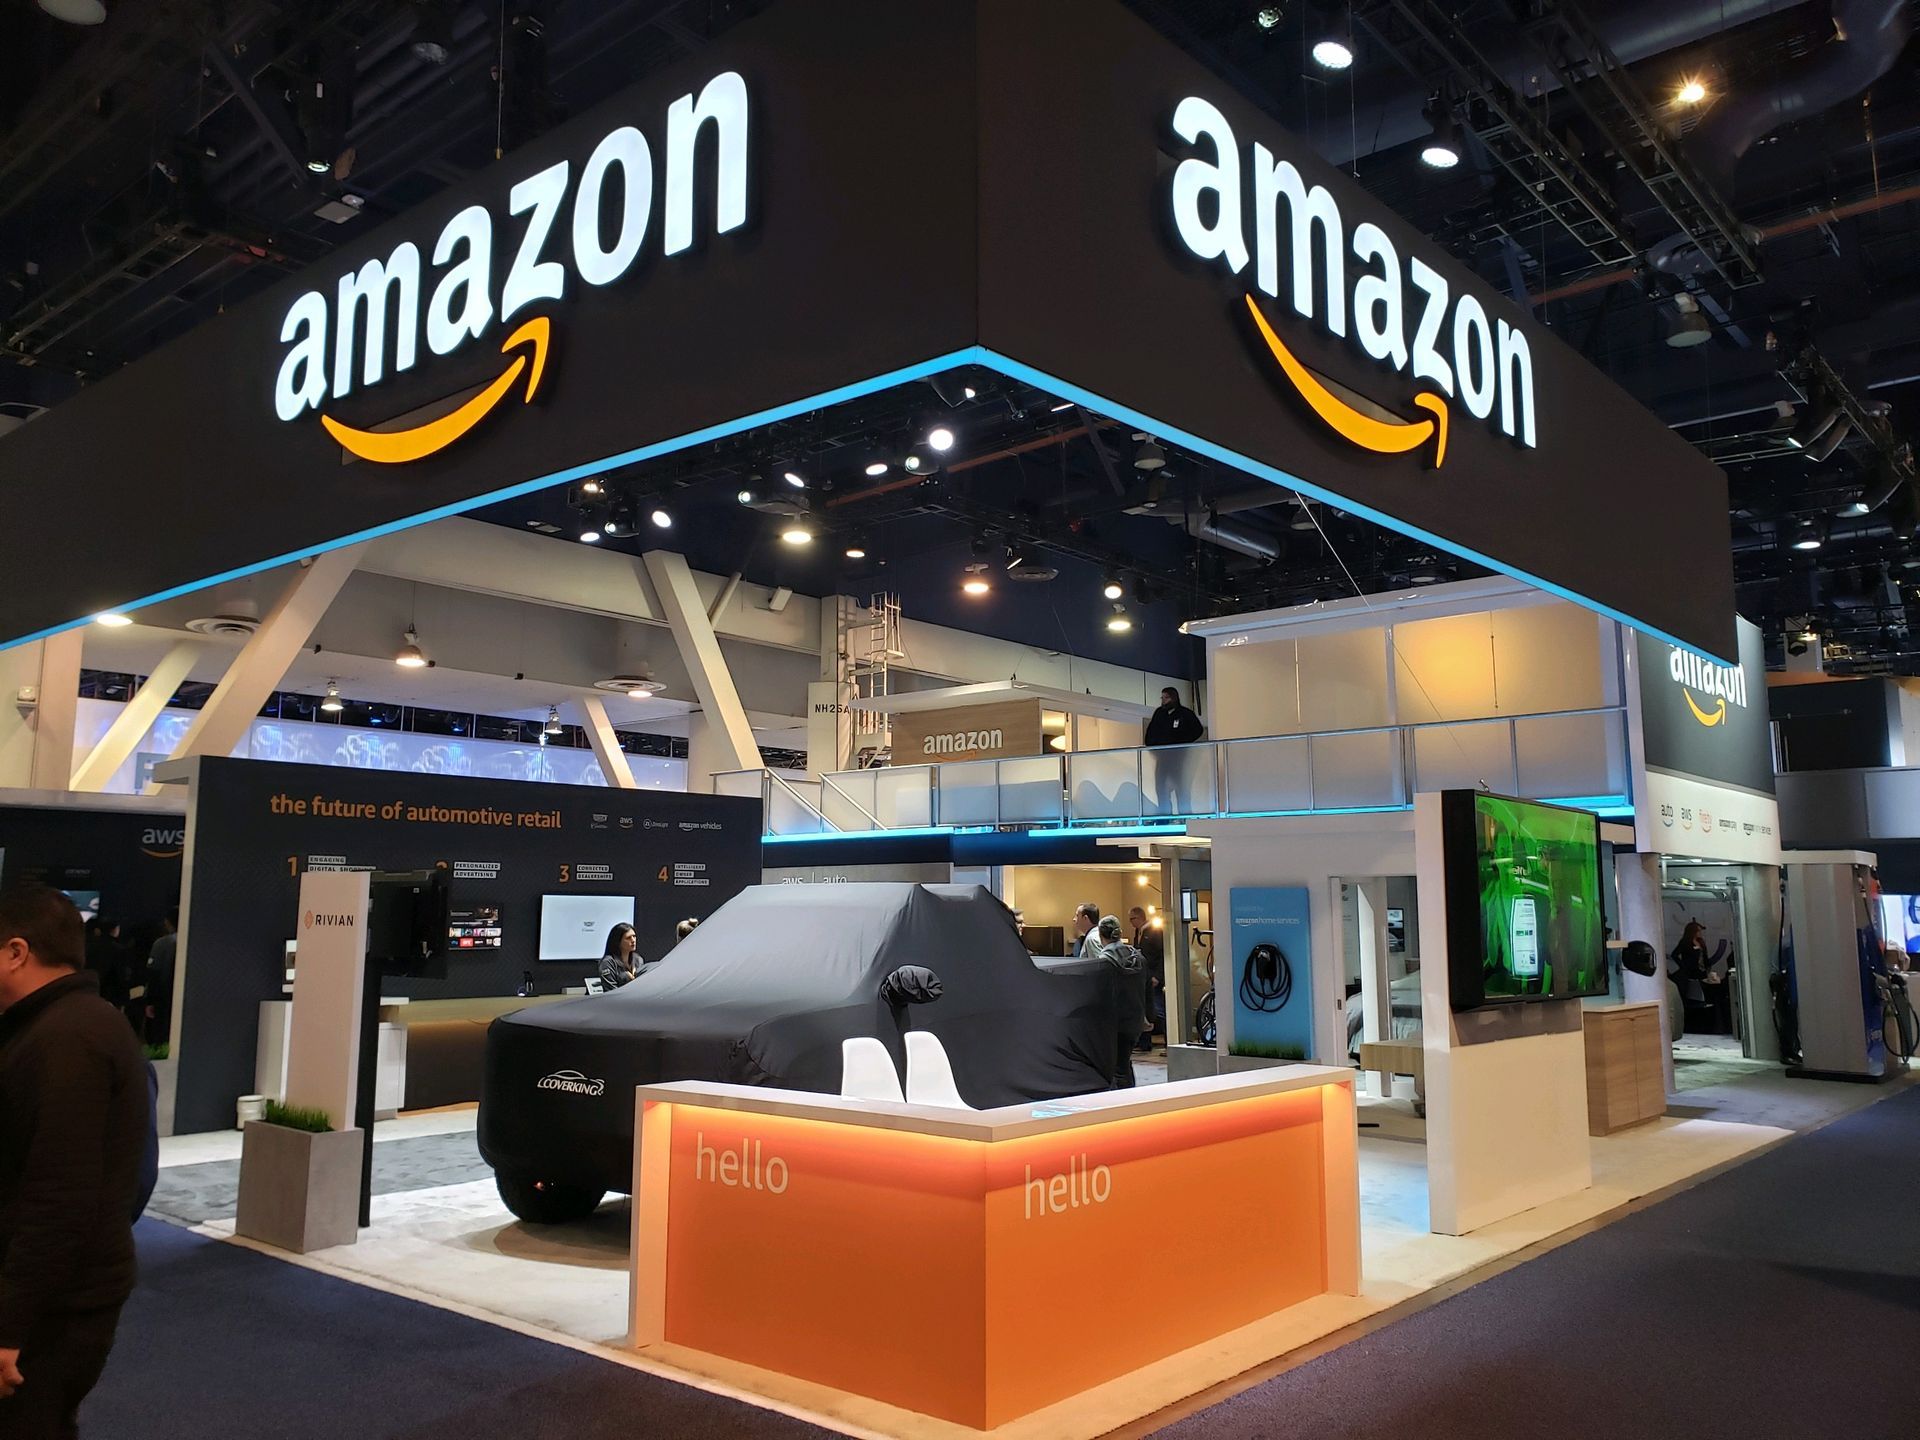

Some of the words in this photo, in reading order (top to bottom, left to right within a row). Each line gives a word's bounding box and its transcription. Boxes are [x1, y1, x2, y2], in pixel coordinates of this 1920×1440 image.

[275, 71, 748, 421] amazon
[1172, 96, 1537, 449] amazon
[923, 729, 1003, 754] amazon
[270, 794, 306, 815] the
[312, 796, 376, 820] future
[381, 801, 403, 822] of
[407, 806, 513, 826] automotive
[517, 811, 562, 829] retail
[142, 828, 185, 845] aws
[287, 856, 298, 877] 1
[559, 864, 570, 883] 3
[658, 866, 669, 882] 4
[315, 914, 355, 927] RIVIAN
[538, 1077, 601, 1096] COVERKING
[696, 1132, 789, 1195] hello
[1025, 1153, 1112, 1220] hello
